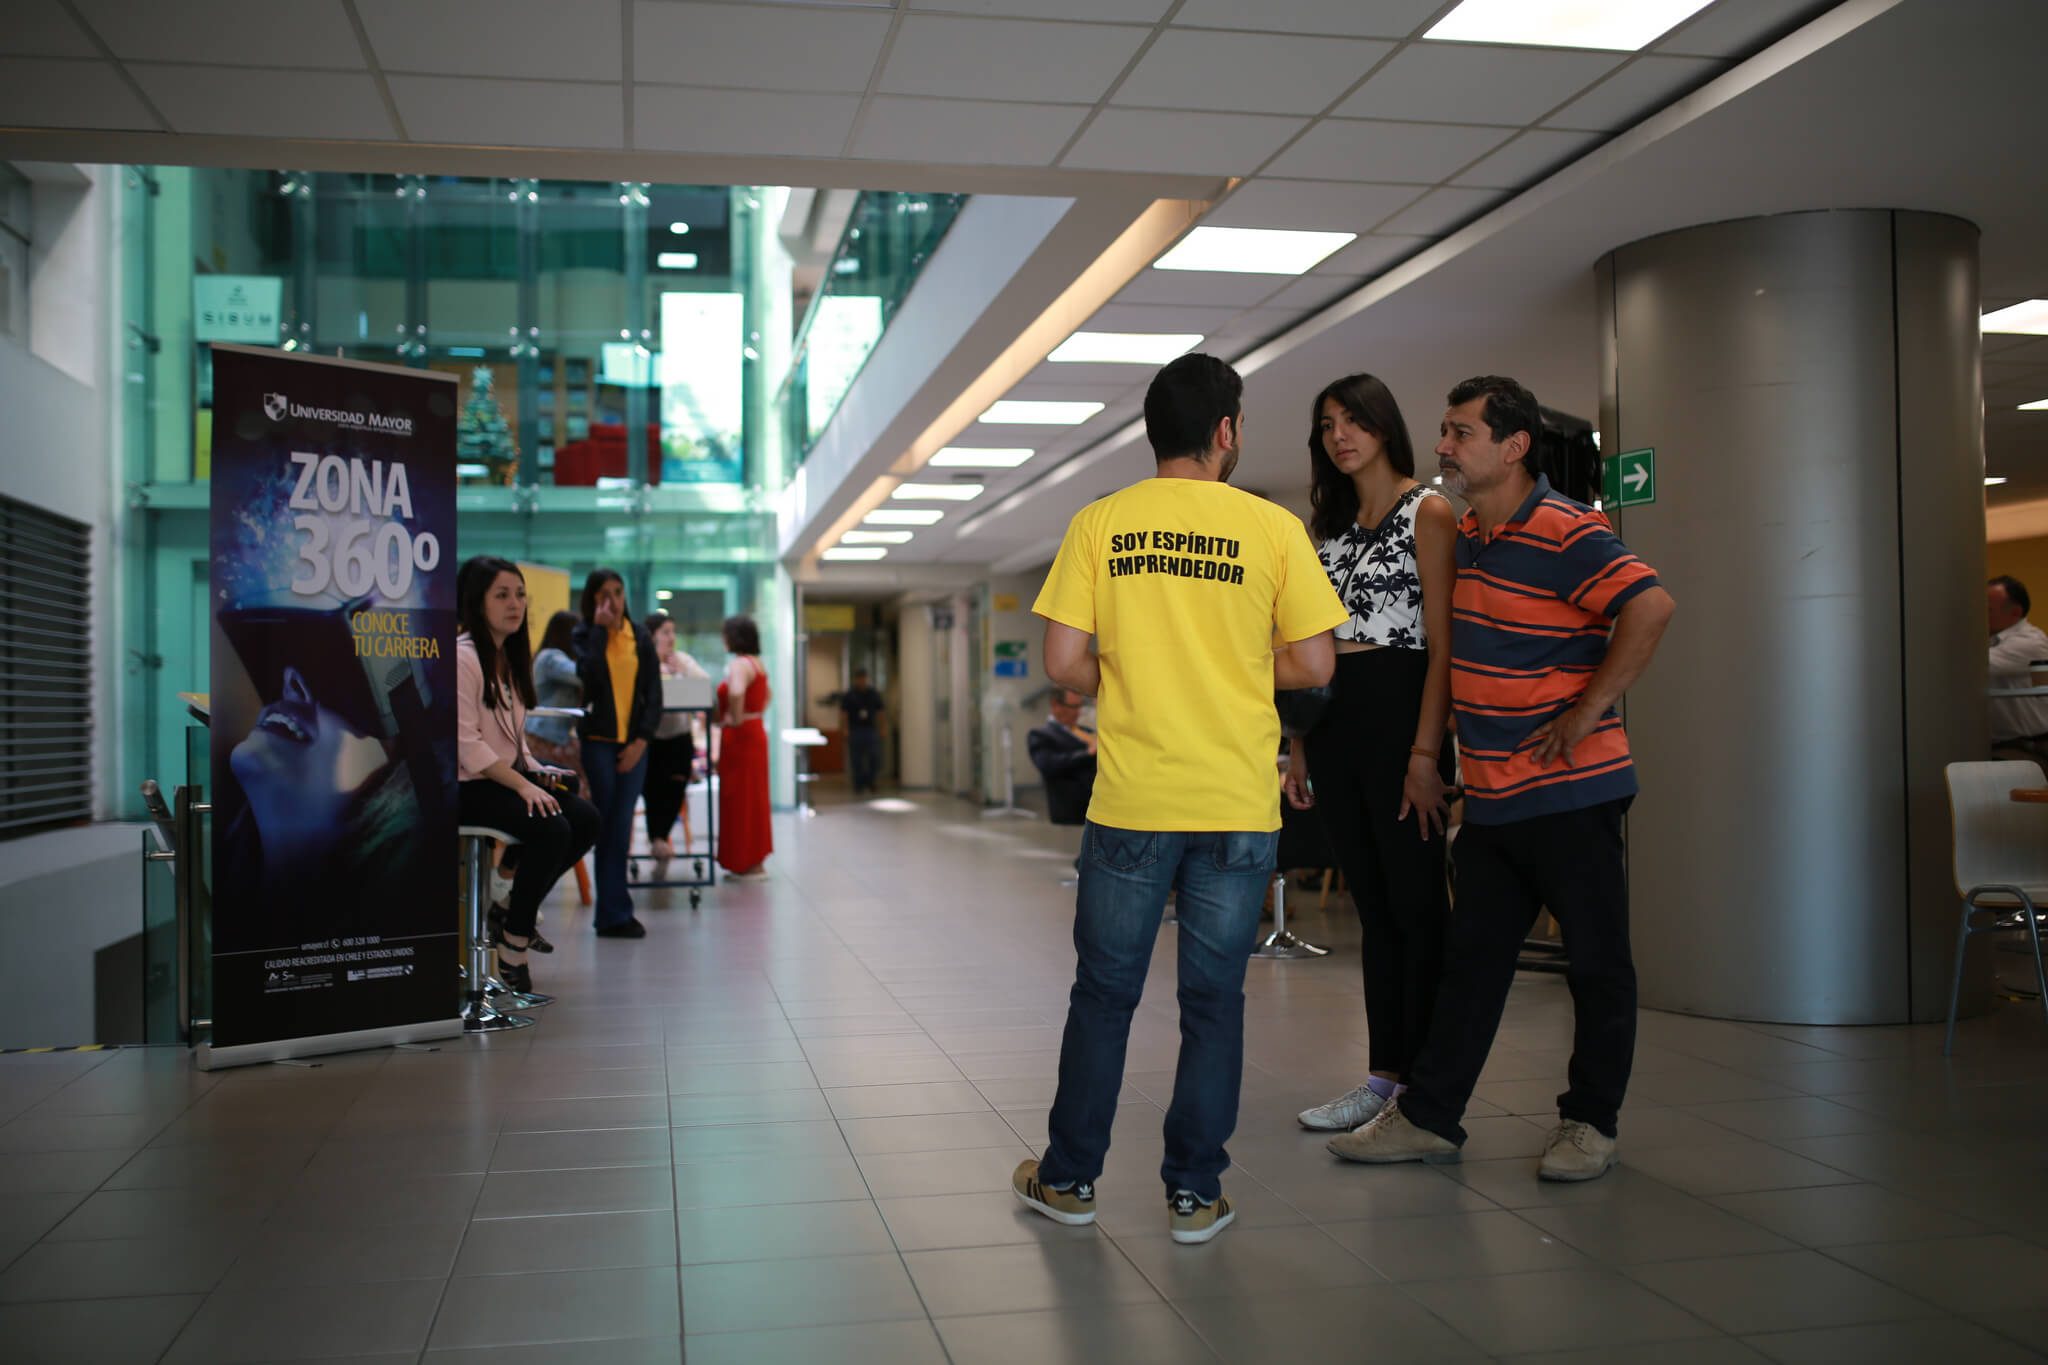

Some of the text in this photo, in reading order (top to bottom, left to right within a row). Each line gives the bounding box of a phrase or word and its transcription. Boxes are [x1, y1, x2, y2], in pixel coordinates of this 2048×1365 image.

[290, 403, 365, 425] UNIVERSIDAD
[369, 413, 412, 431] MAYOR
[289, 451, 414, 519] ZONA
[1111, 530, 1240, 559] SOY ESPÍRITU
[1108, 554, 1245, 585] EMPRENDEDOR
[352, 611, 409, 635] CONOCE
[352, 635, 440, 659] TU CARRERA
[264, 959, 291, 969] CALIDAD
[336, 953, 344, 962] EN
[344, 951, 361, 961] CHILE
[366, 949, 392, 959] ESTADOS
[392, 947, 414, 957] UNIDOS
